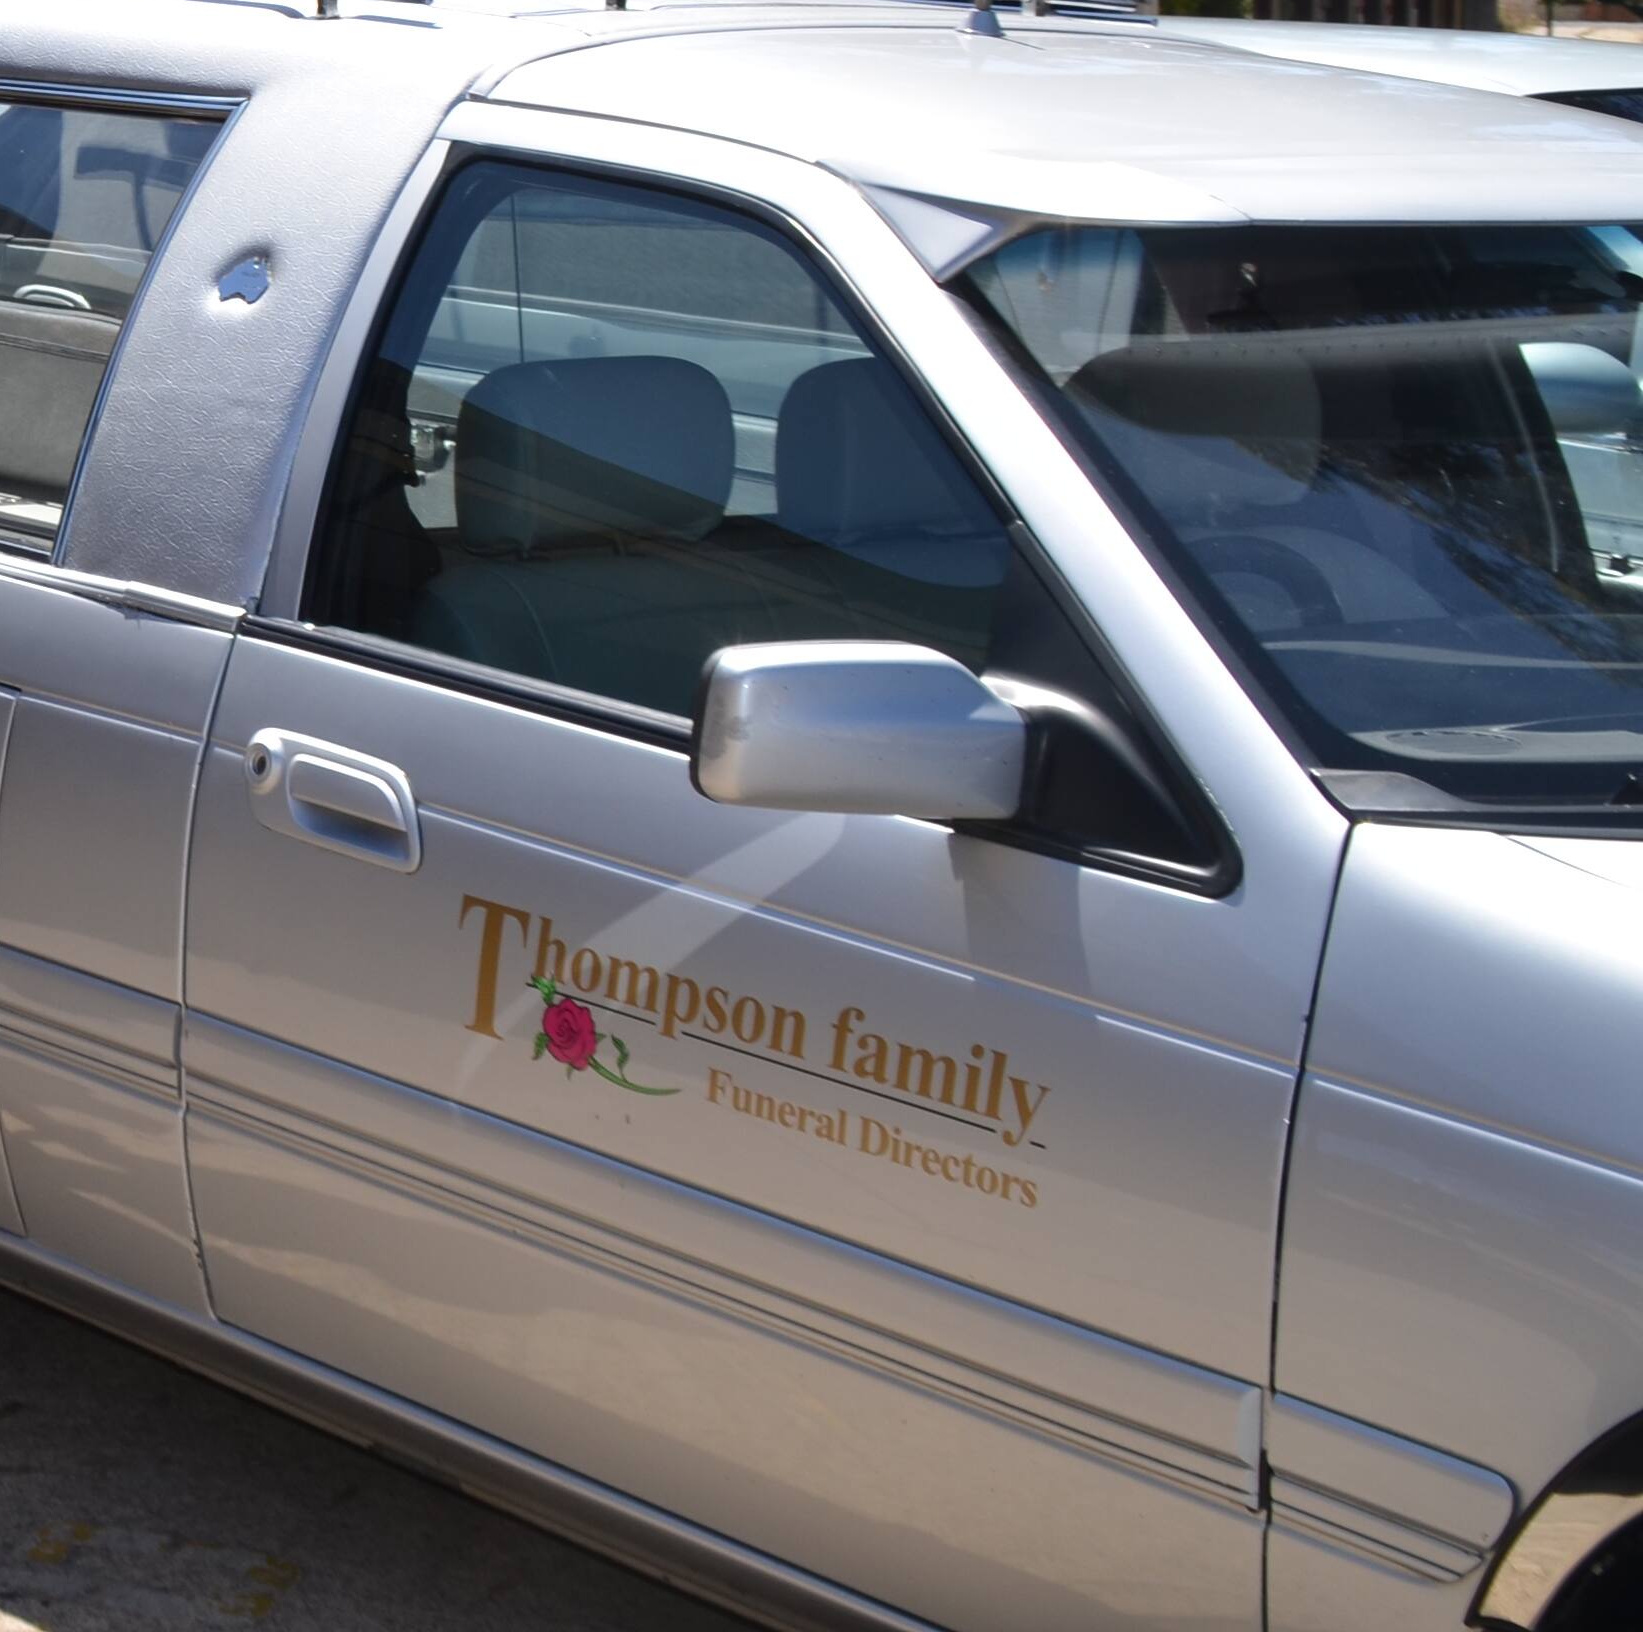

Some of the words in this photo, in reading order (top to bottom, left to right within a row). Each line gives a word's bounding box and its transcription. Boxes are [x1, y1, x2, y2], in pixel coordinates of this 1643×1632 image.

[458, 893, 807, 1061] Thompson
[828, 1005, 1052, 1147] family
[704, 1066, 849, 1147] Funeral
[856, 1113, 1039, 1210] Directors
